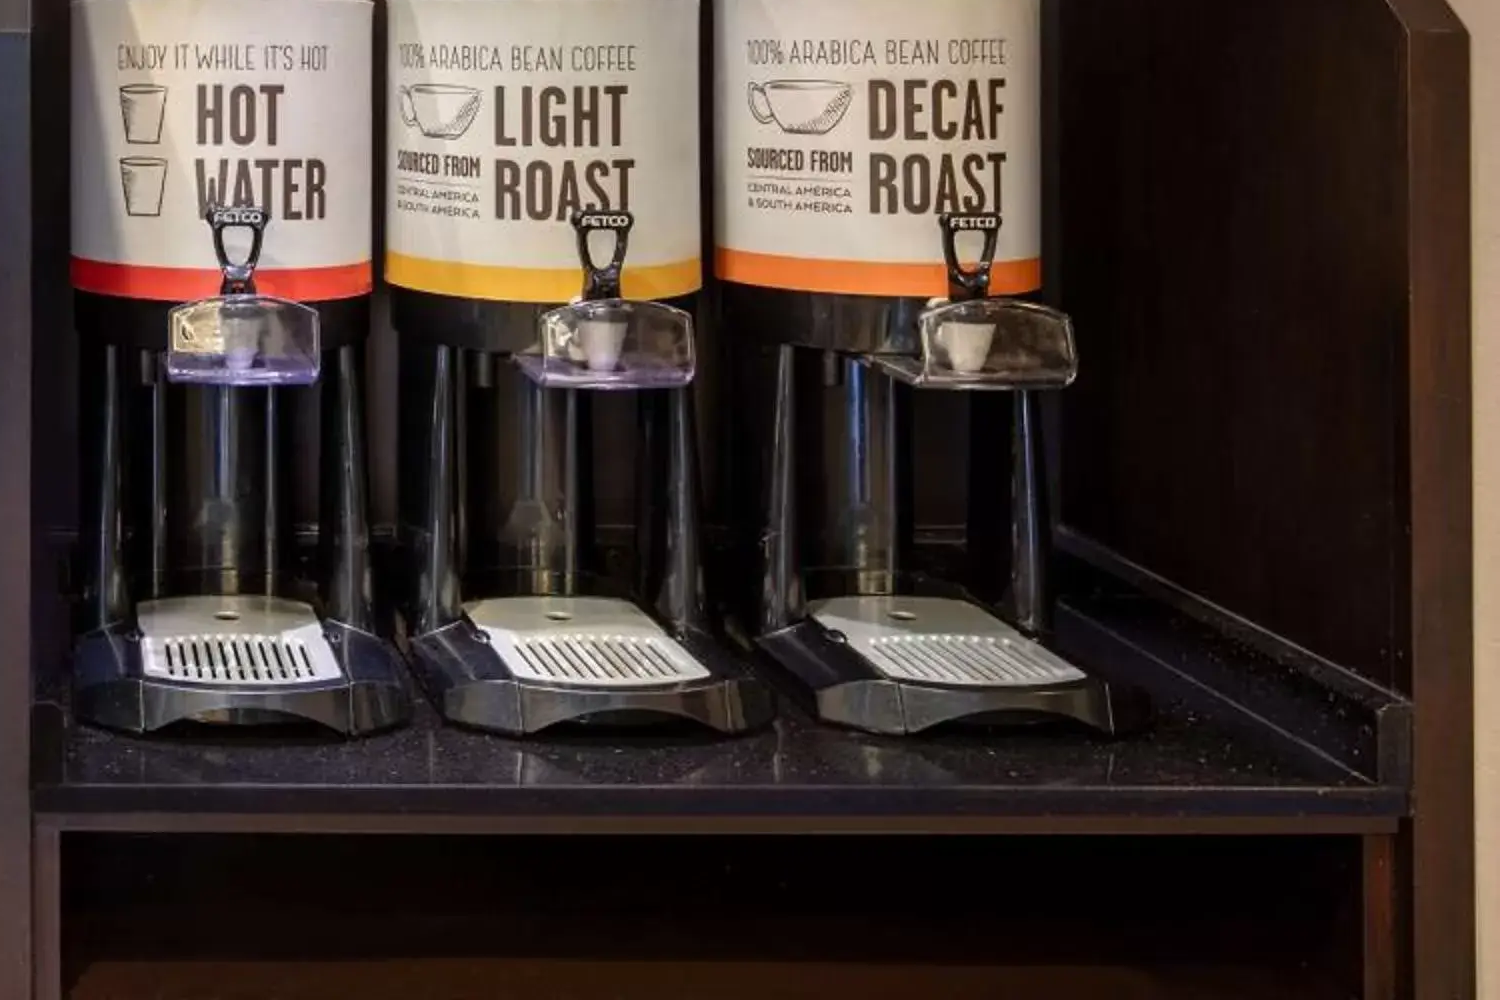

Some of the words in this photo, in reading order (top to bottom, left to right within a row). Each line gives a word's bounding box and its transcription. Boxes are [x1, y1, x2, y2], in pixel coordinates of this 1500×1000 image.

[117, 44, 168, 71] ENJOY
[175, 44, 189, 70] IT
[195, 44, 256, 71] WHILE
[265, 45, 294, 71] IT'S
[301, 45, 329, 71] HOT
[430, 44, 502, 71] ARABICA
[511, 45, 563, 71] BEAN
[571, 45, 636, 71] COFFEE
[746, 39, 784, 65] 100%
[789, 39, 876, 65] ARABICA
[885, 40, 939, 65] BEAN
[948, 39, 1007, 65] COFFEE
[197, 84, 285, 145] HOT
[494, 85, 628, 147] LIGHT
[868, 78, 1007, 141] DECAF
[397, 150, 439, 176] SOURCED
[444, 154, 480, 178] FROM
[747, 147, 804, 171] SOURCED
[811, 151, 853, 173] FROM
[195, 158, 327, 220] WATER
[431, 188, 479, 203] AMERICA
[494, 158, 635, 222] ROAST
[747, 183, 792, 196] CENTRAL
[795, 184, 852, 199] AMERICA
[868, 152, 1007, 215] ROAST
[213, 210, 263, 223] FETCO
[431, 204, 480, 219] AMERICA
[756, 197, 793, 210] SOUTH
[795, 200, 853, 214] AMERICA
[580, 215, 629, 228] FETCO
[950, 216, 996, 229] FETCO
